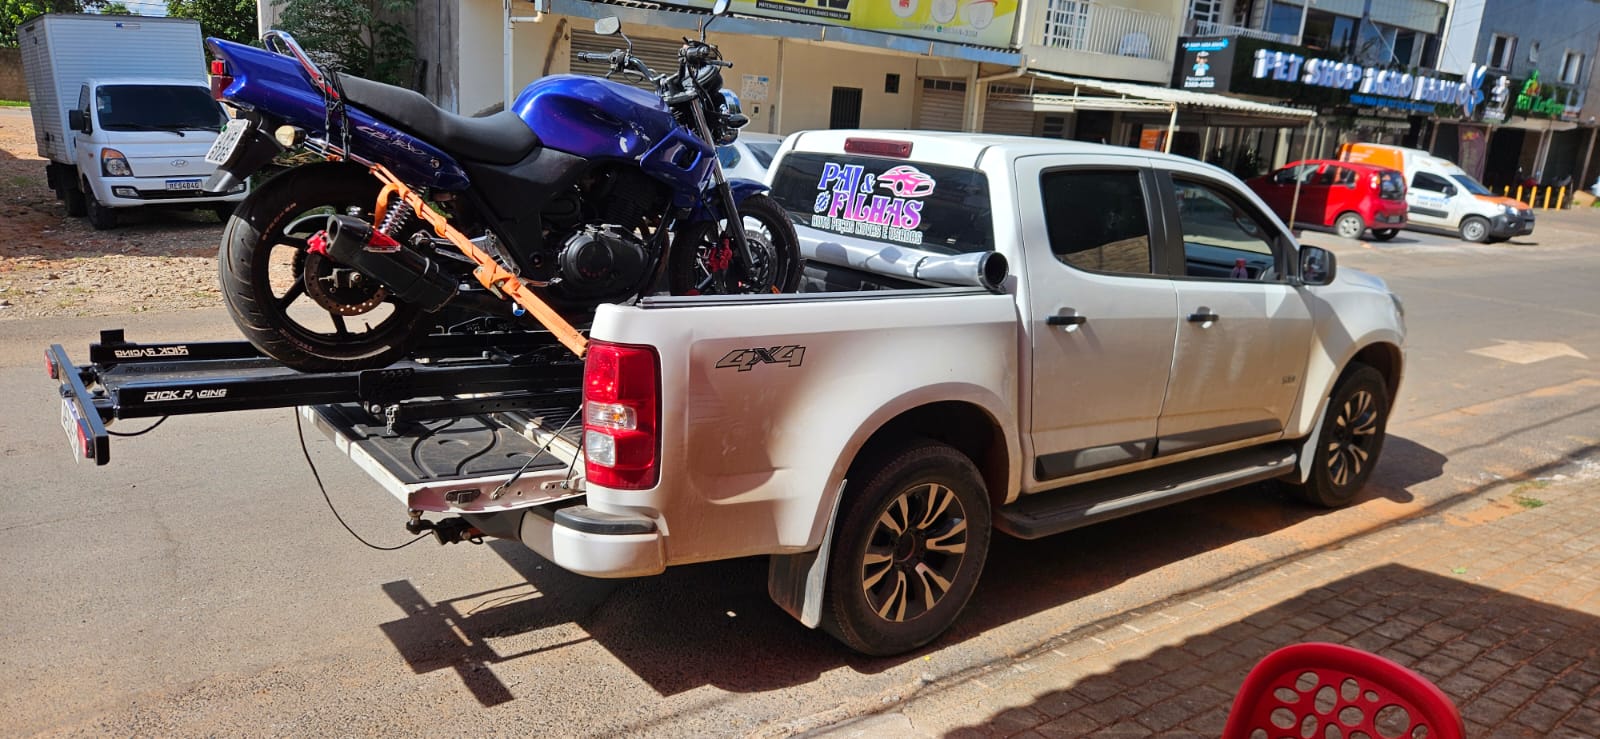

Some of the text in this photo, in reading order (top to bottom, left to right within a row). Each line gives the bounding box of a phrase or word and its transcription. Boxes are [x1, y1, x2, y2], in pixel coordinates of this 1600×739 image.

[1252, 49, 1304, 82] PET
[1301, 58, 1362, 90] SHOP
[1359, 67, 1413, 97] AGRO
[818, 162, 876, 193] PAI &
[828, 191, 924, 230] FILHAS
[811, 214, 922, 244] AUTO PEÇAS NOVAS E USADAS
[143, 390, 182, 402] RICK
